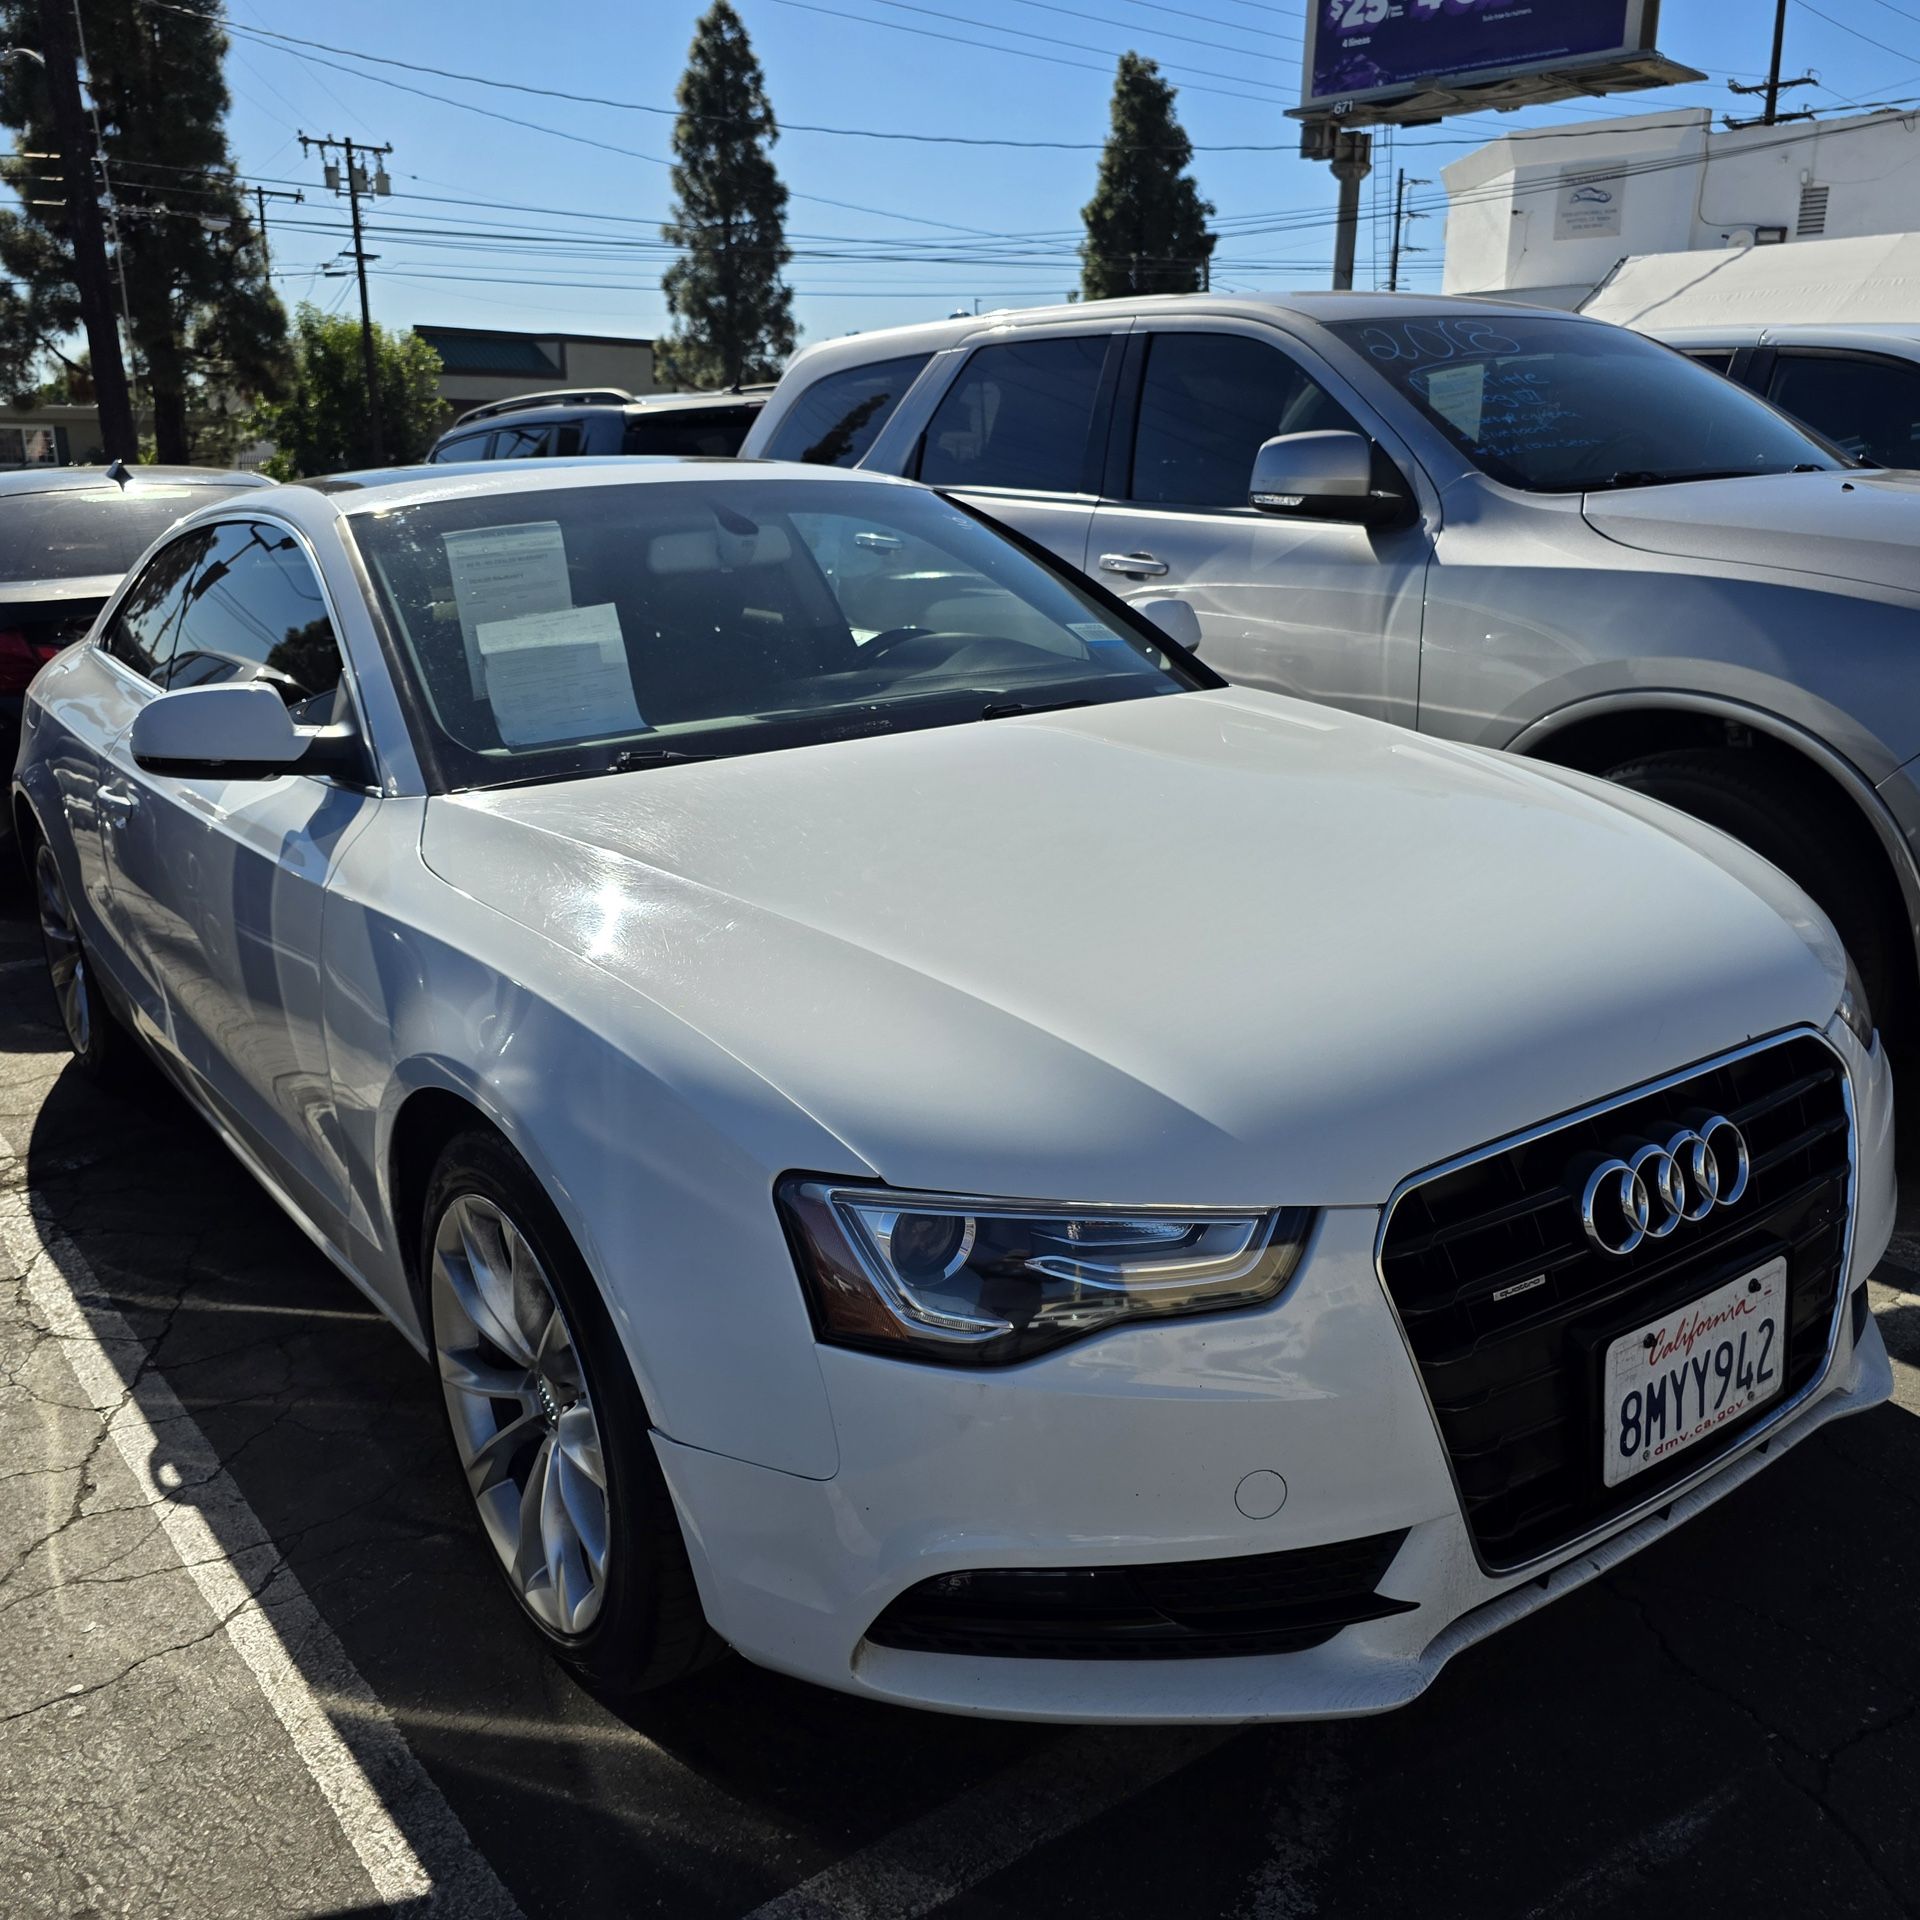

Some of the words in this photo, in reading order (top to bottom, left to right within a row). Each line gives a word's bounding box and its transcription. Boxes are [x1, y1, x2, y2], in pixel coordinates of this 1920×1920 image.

[1333, 100, 1354, 115] 671
[1360, 320, 1521, 360] 2018
[1649, 1294, 1757, 1366] California
[1619, 1317, 1775, 1458] 8MYY942
[1653, 1399, 1744, 1456] dmv.ca.gov
